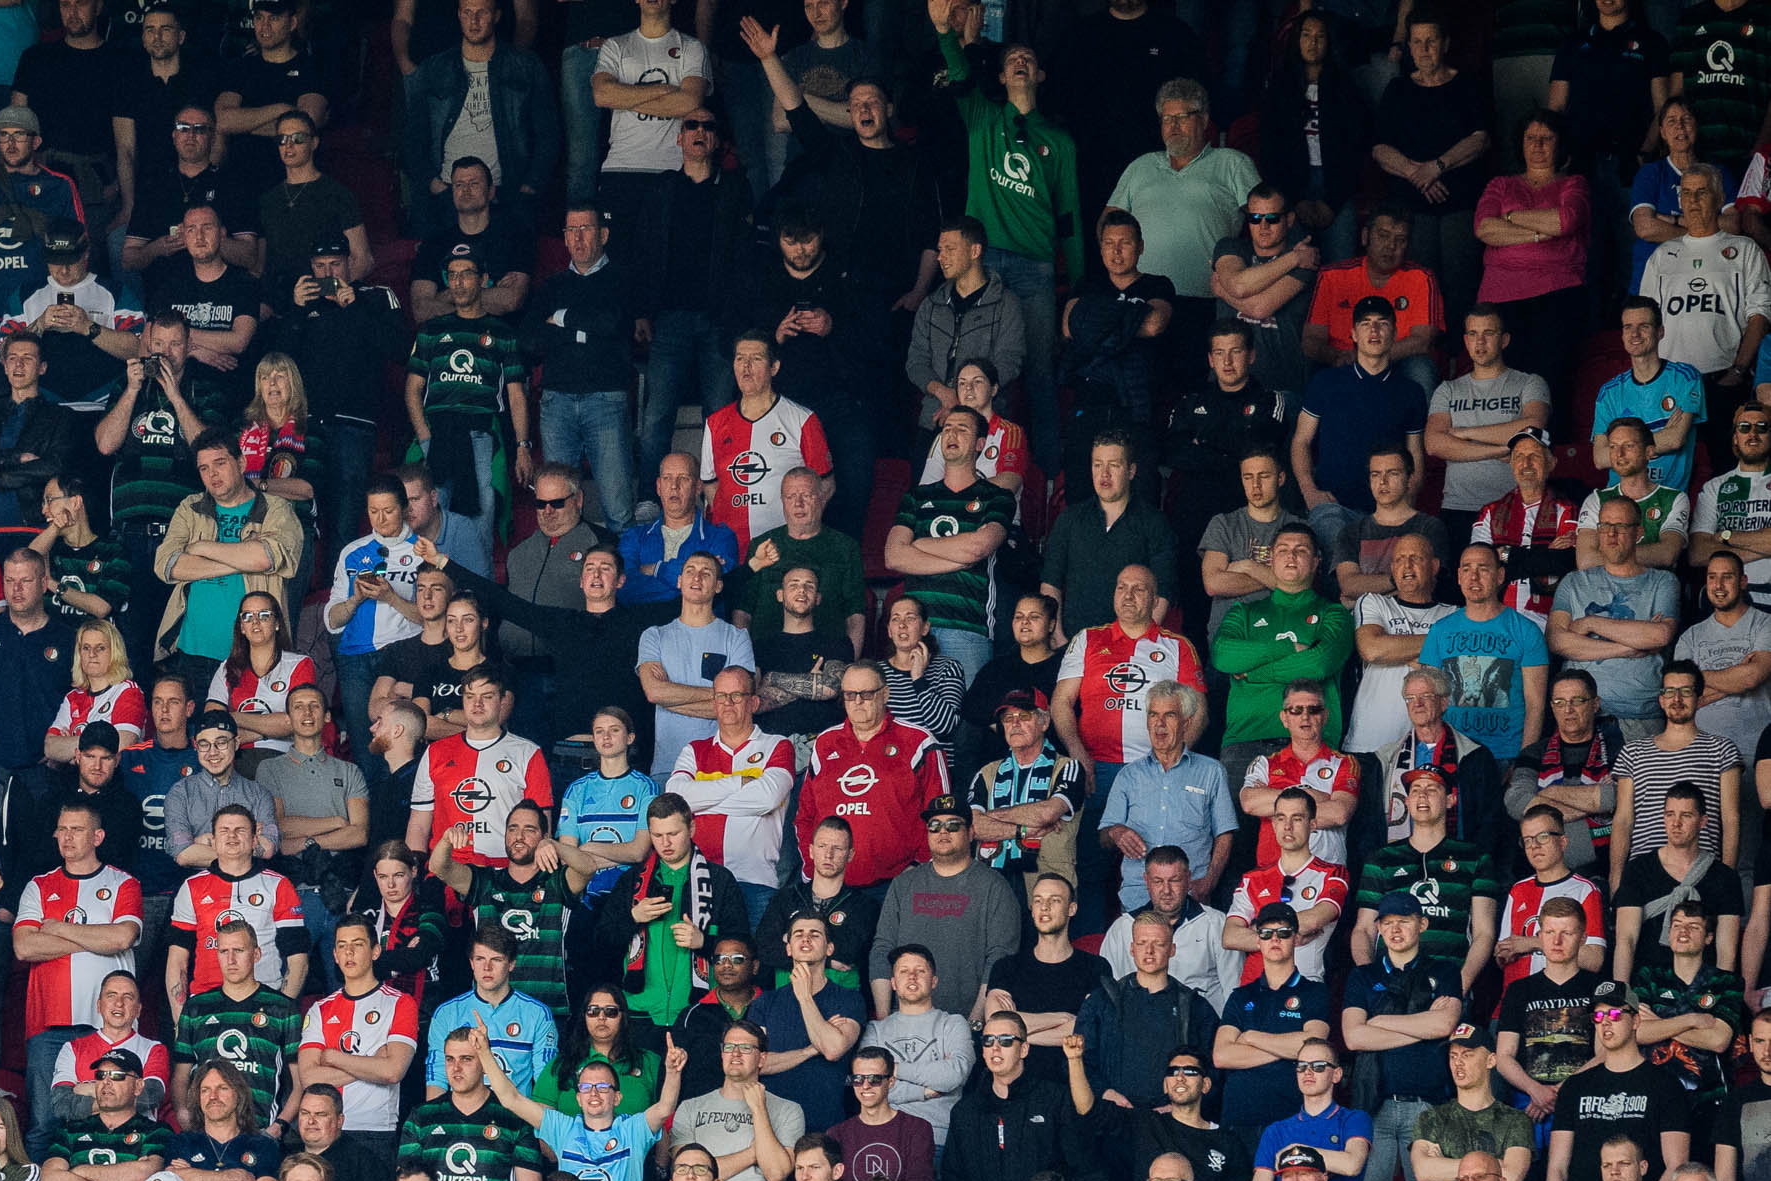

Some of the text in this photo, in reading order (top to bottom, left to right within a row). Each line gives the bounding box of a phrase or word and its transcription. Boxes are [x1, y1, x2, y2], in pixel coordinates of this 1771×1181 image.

[1667, 294, 1726, 315] OPEL
[440, 372, 482, 385] Qurrent
[1448, 397, 1521, 413] HILFIGER
[732, 492, 767, 508] OPEL
[1105, 697, 1142, 711] OPEL
[835, 802, 872, 816] OPEL
[1421, 904, 1451, 918] rent
[1525, 997, 1591, 1013] AWAYDAYS
[1579, 1094, 1648, 1116] FRFC 1908
